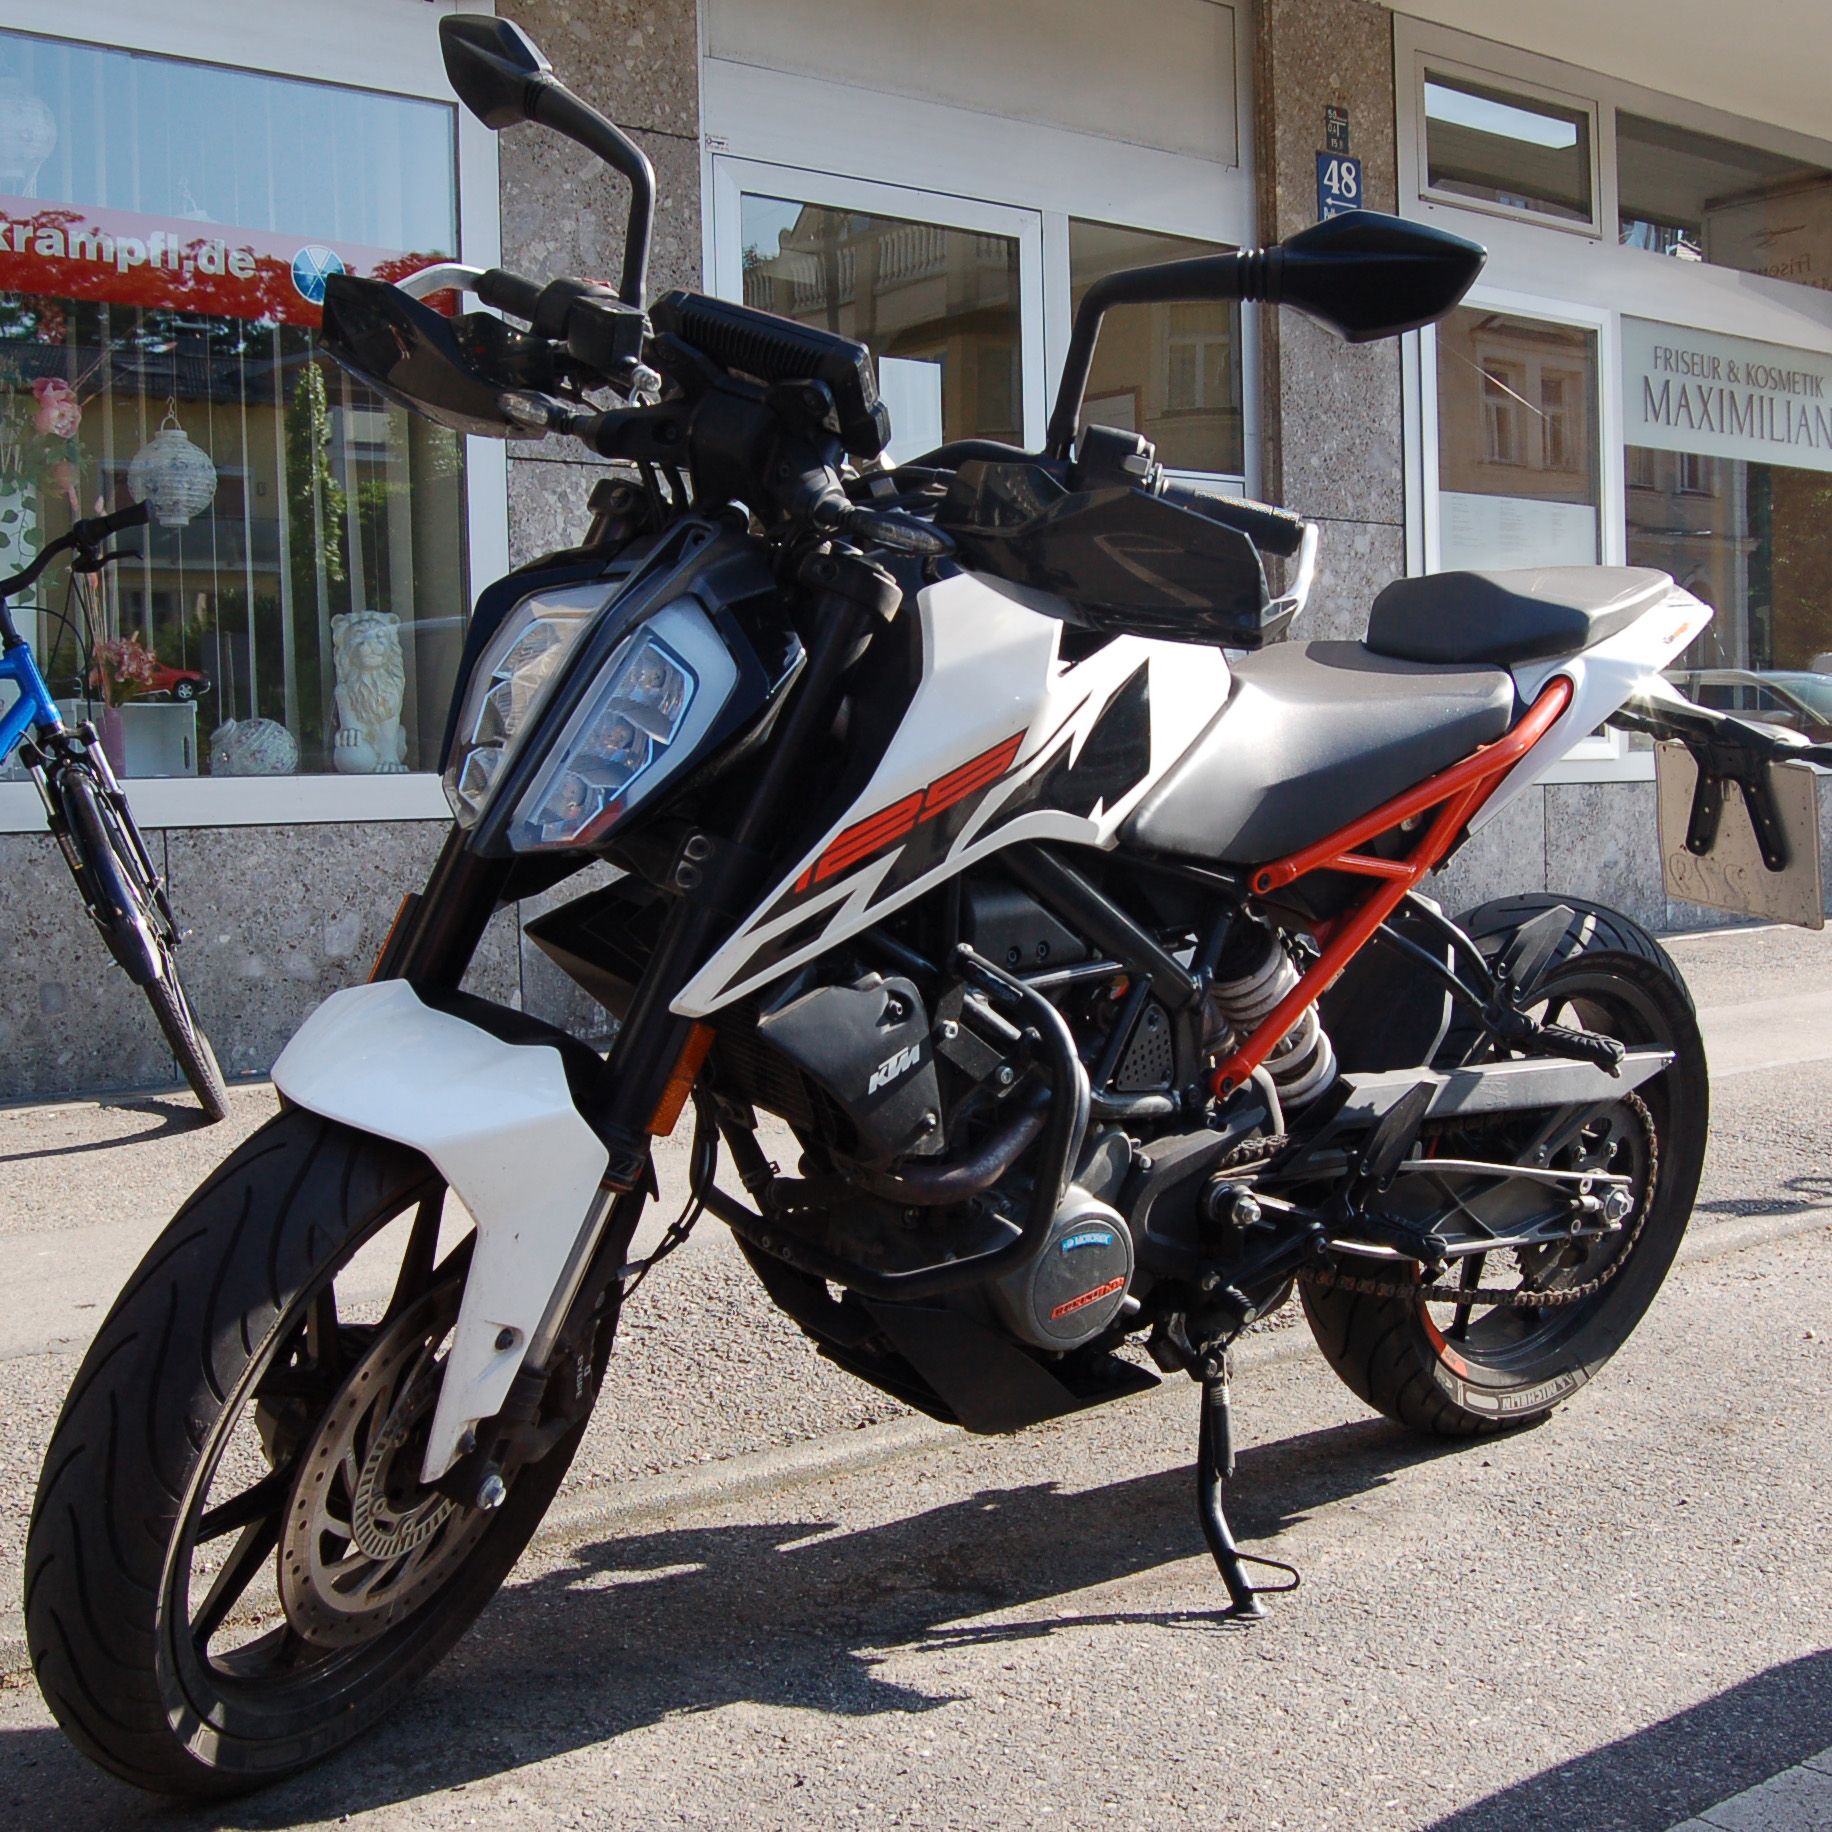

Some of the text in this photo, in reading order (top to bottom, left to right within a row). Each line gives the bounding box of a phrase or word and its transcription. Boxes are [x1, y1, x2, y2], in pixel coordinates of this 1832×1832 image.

[1323, 160, 1357, 199] 48
[1654, 345, 1825, 399] FRISEUR & KOSMETIK
[1643, 375, 1832, 450] MAXIMILIAN
[794, 727, 1028, 894] 125
[867, 1043, 920, 1095] KTM
[1501, 1381, 1558, 1411] MICHELIN
